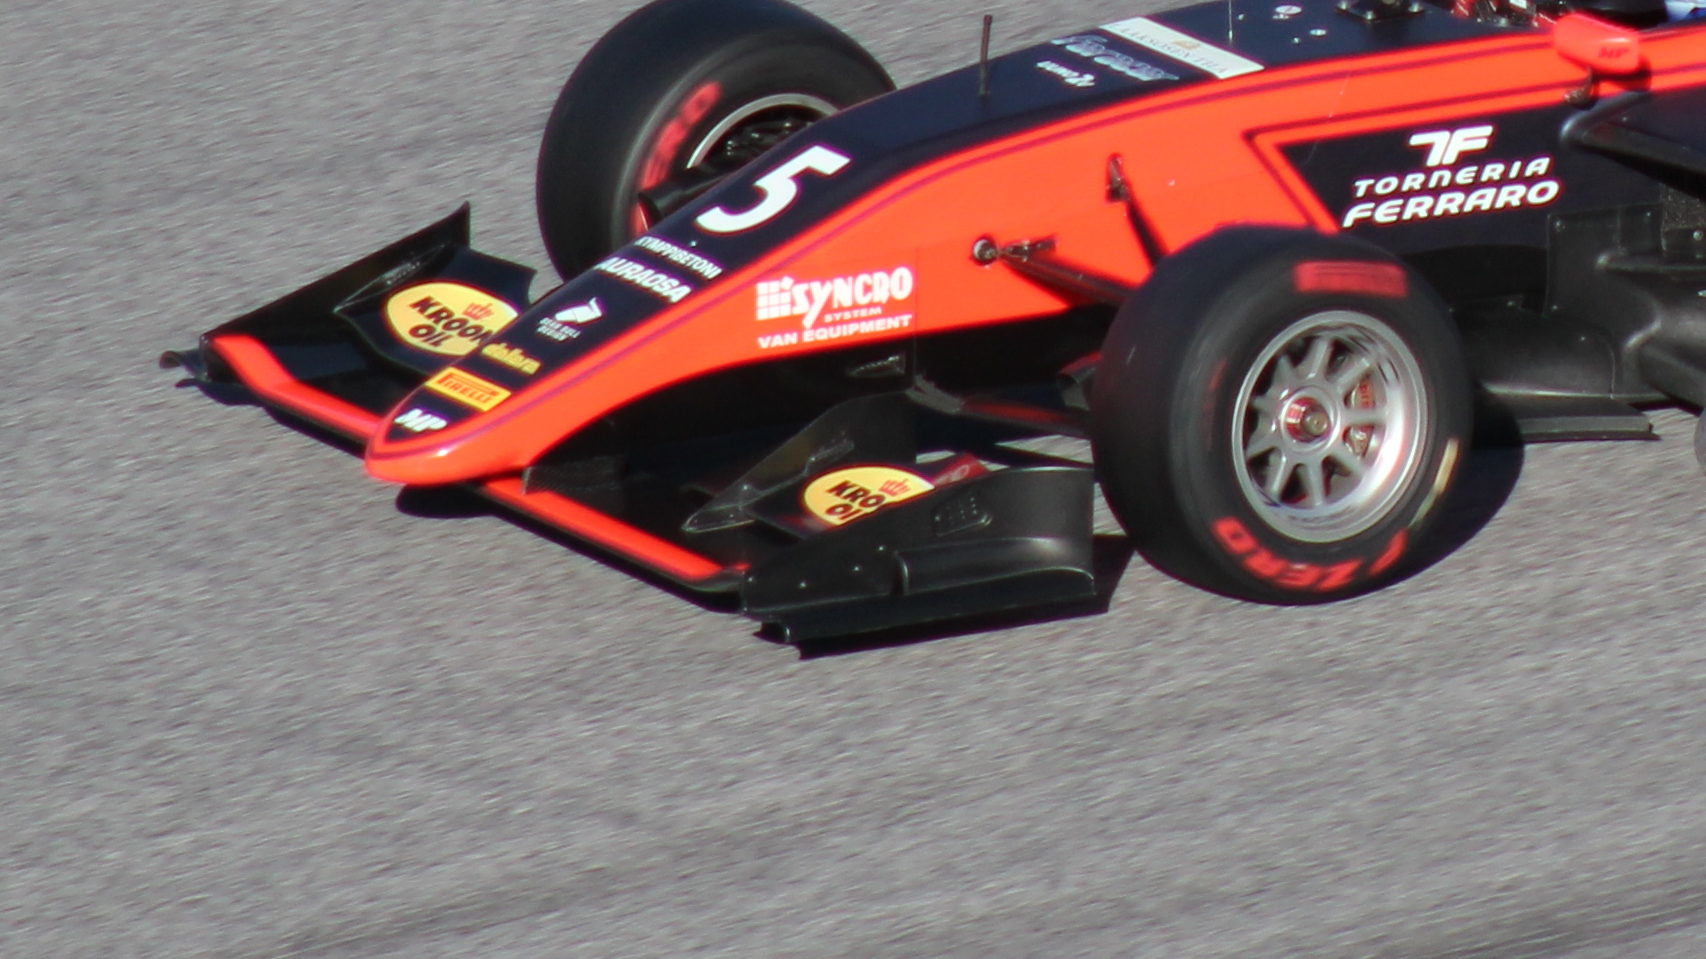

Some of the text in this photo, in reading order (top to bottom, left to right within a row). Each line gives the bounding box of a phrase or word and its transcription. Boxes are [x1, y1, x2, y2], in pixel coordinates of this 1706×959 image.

[696, 145, 851, 232] 5
[1354, 157, 1550, 198] TORNERIA
[1342, 180, 1559, 228] FERRARO
[824, 306, 882, 323] SYSTEM
[408, 324, 454, 348] OIL
[758, 314, 913, 349] VAN EQUIPMENT
[437, 372, 500, 404] PIRELLI
[825, 480, 886, 508] KRO
[825, 504, 863, 520] OI
